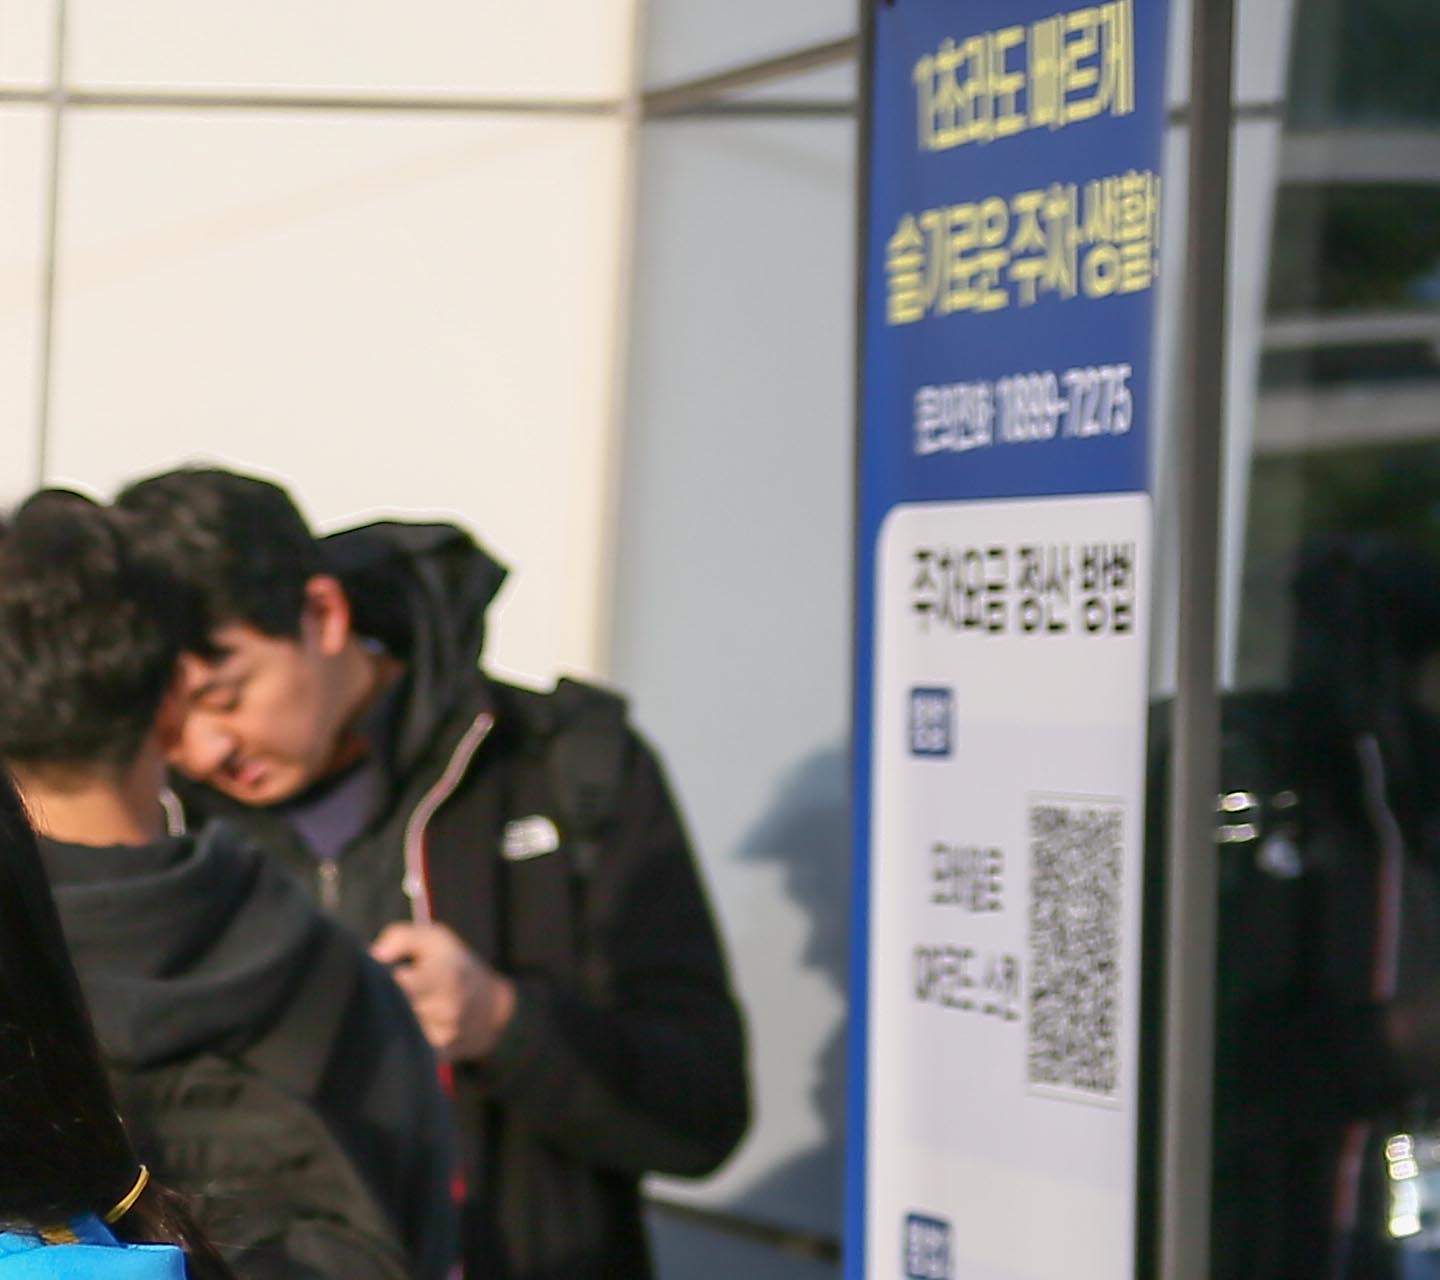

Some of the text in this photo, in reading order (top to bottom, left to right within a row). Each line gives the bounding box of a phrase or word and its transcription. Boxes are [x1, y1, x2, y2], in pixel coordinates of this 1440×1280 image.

[887, 169, 1160, 326] 슬기로운 주차 생활
[911, 547, 1008, 636] 주차요금
[1081, 541, 1136, 635] 방법
